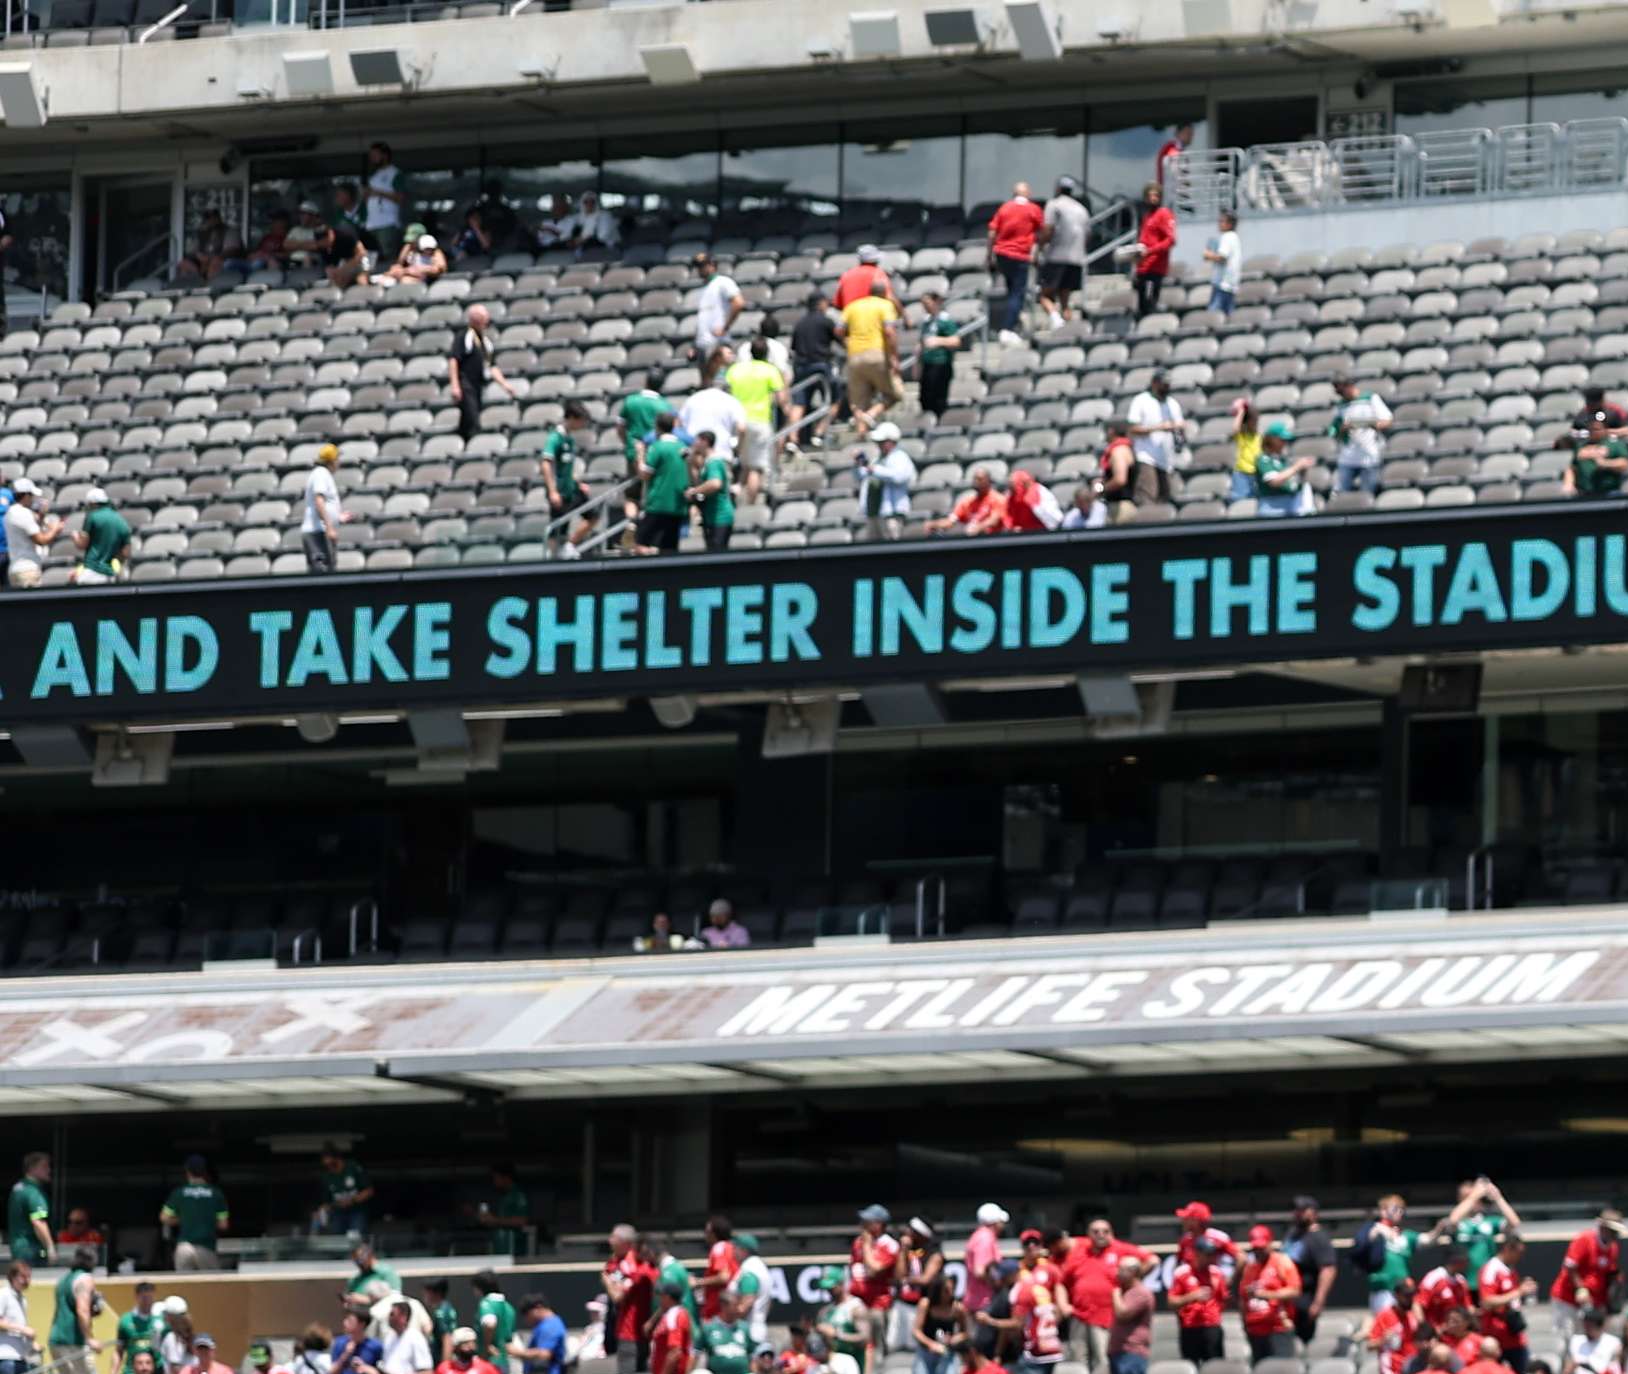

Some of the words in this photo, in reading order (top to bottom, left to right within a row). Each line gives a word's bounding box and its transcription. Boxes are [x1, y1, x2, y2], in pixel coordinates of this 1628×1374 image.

[31, 615, 219, 698] AND
[250, 602, 452, 688] TAKE
[485, 582, 821, 677] SHELTER
[853, 563, 1130, 657] INSIDE
[1162, 552, 1317, 639] THE
[716, 970, 1151, 1037] METLIFE
[1142, 949, 1601, 1020] STADIUM
